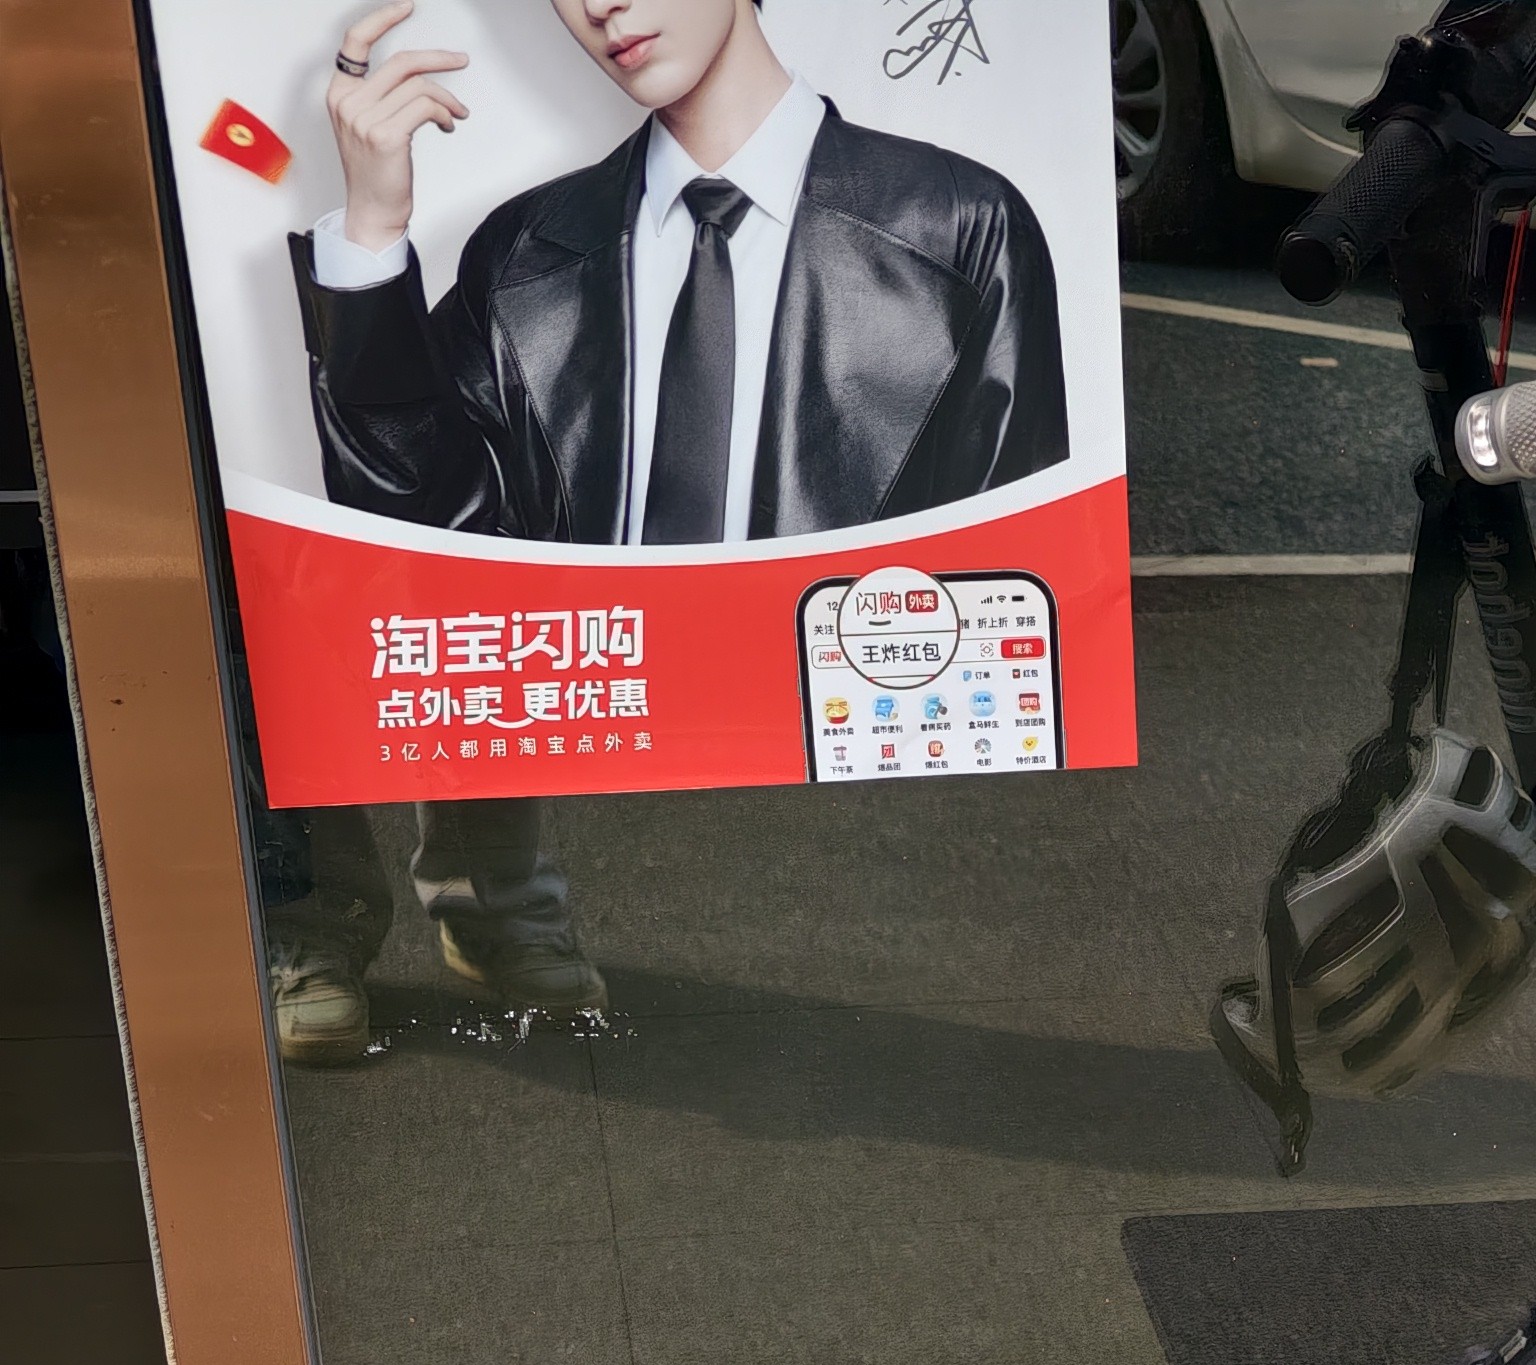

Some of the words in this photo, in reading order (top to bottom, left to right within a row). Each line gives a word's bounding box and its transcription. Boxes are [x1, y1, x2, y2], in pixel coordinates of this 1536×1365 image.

[856, 591, 901, 616] 闪购
[909, 594, 935, 609] 外卖
[978, 617, 1009, 628] 折上折
[371, 605, 644, 679] 淘宝闪购
[862, 642, 941, 663] 王炸红包
[377, 686, 503, 729] 点外卖
[522, 678, 650, 722] 更优惠
[380, 732, 653, 761] 3亿人都用淘宝点外卖
